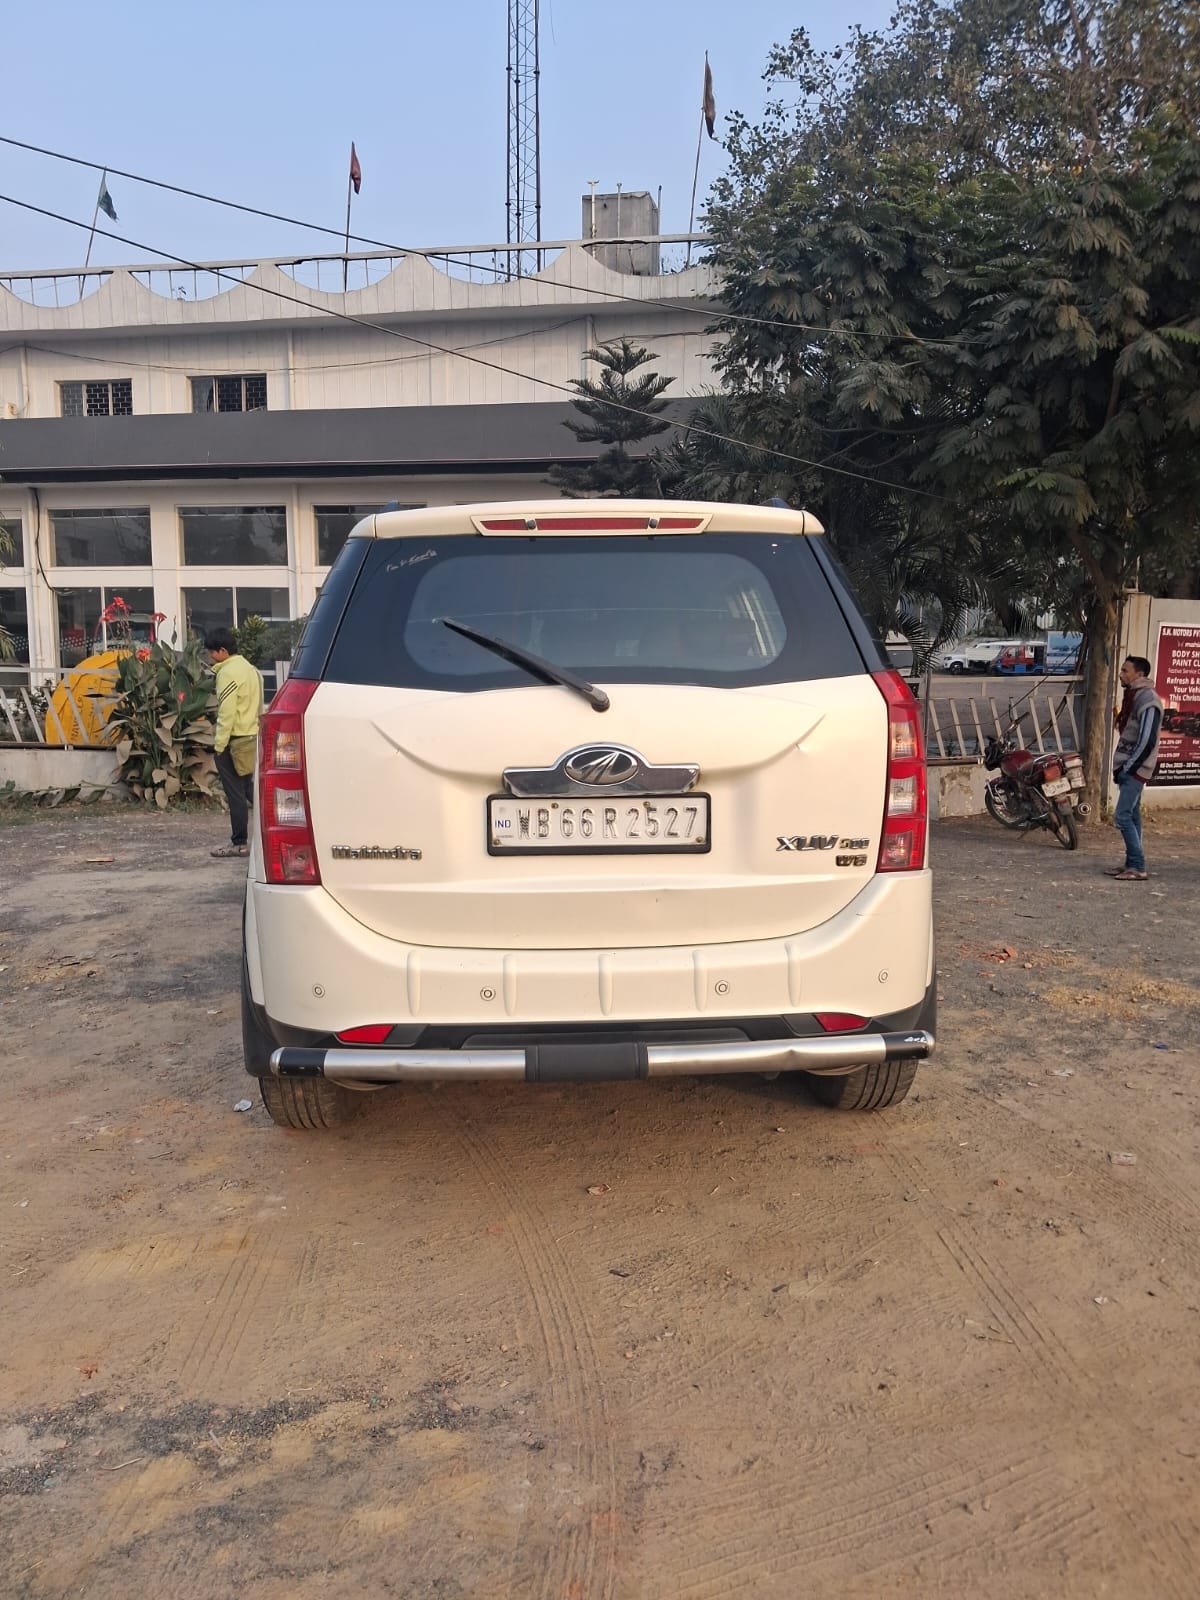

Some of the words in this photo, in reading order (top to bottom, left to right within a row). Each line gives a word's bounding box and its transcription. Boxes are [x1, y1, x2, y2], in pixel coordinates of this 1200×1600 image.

[1172, 628, 1193, 637] MOTORS
[1172, 650, 1190, 658] BODY
[1172, 659, 1192, 667] PAINT
[494, 820, 512, 829] IND
[516, 807, 551, 839] WB
[560, 807, 596, 839] 66
[602, 807, 618, 838] R
[625, 806, 699, 839] 2527
